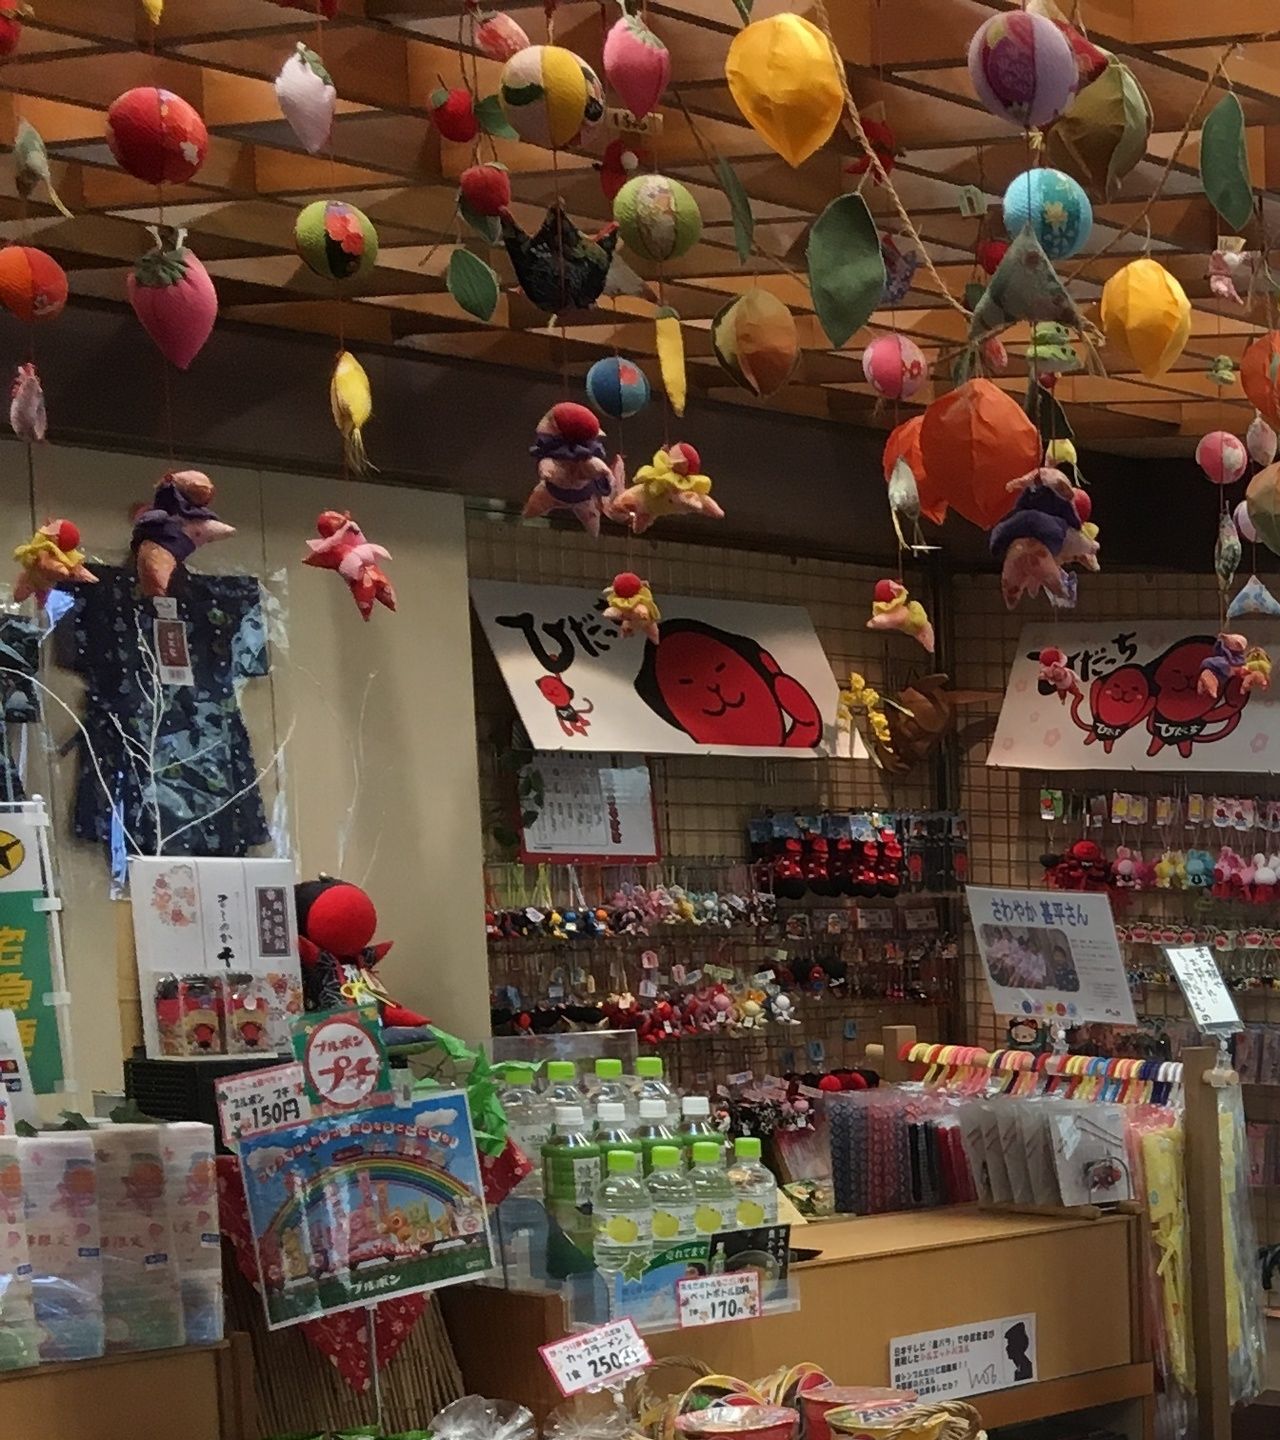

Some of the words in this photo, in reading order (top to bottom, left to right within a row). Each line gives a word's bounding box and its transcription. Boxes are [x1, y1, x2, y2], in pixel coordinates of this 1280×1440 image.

[991, 897, 1037, 922] さわやか
[1039, 900, 1088, 926] 甚平さん
[314, 1035, 363, 1055] ブルボン
[317, 1055, 376, 1095] プチ
[230, 1093, 265, 1110] ブルボン
[251, 1097, 299, 1128] 150円
[349, 1274, 400, 1295] ブルボン
